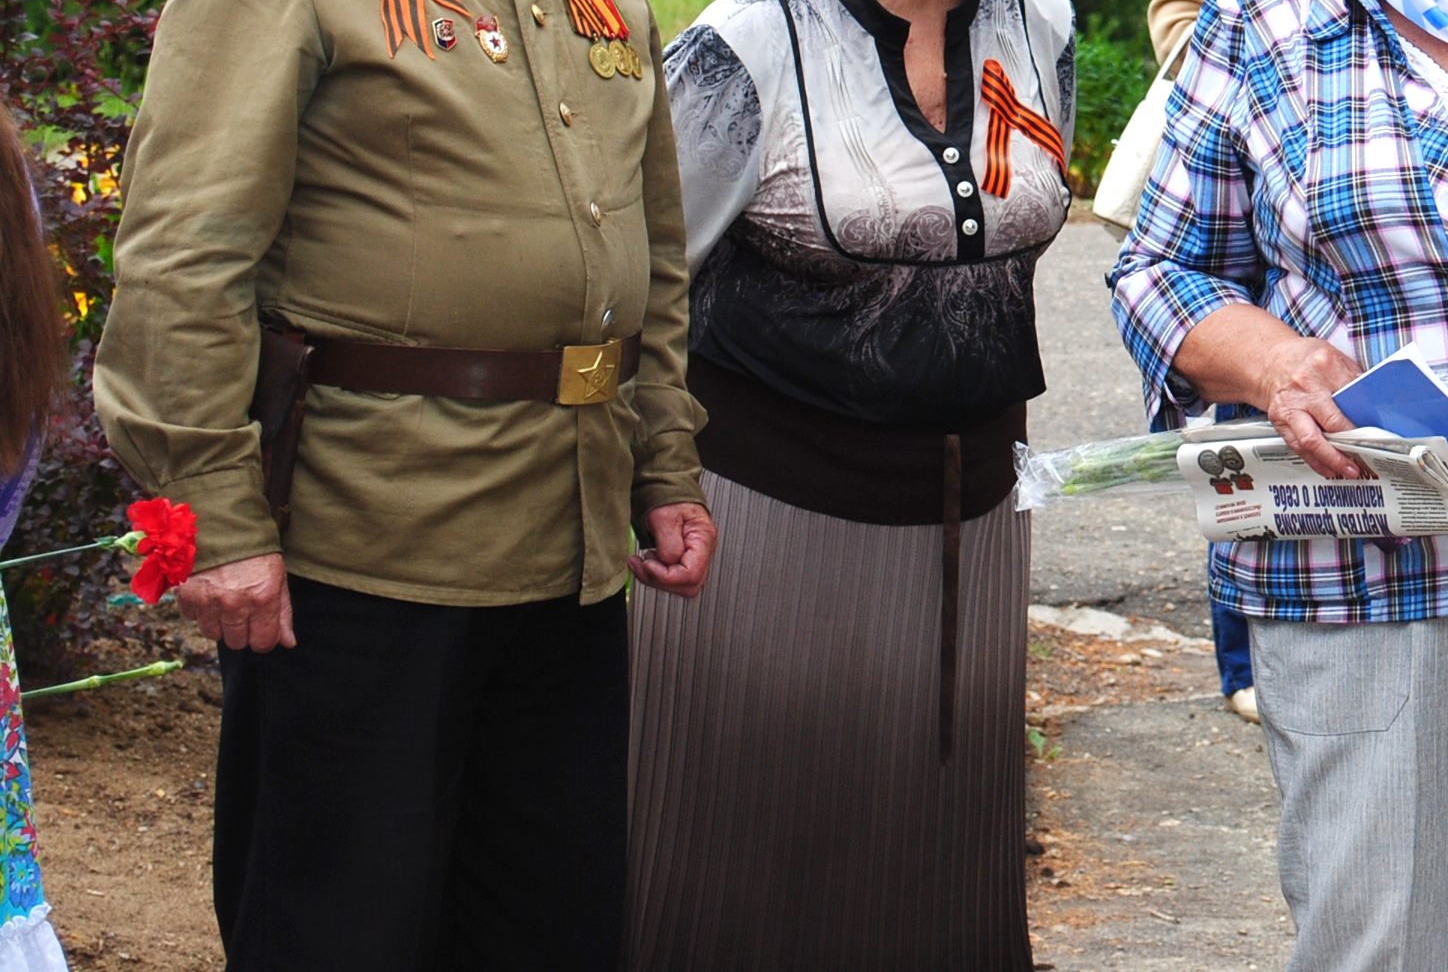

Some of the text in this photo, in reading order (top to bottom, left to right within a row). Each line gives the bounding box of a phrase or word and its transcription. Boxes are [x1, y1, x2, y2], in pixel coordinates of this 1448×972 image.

[1268, 484, 1300, 513] себе.
[1301, 484, 1310, 507] о
[1312, 484, 1385, 508] напоминают
[1273, 508, 1337, 538] фашизма
[1337, 510, 1396, 538] Мертвы
